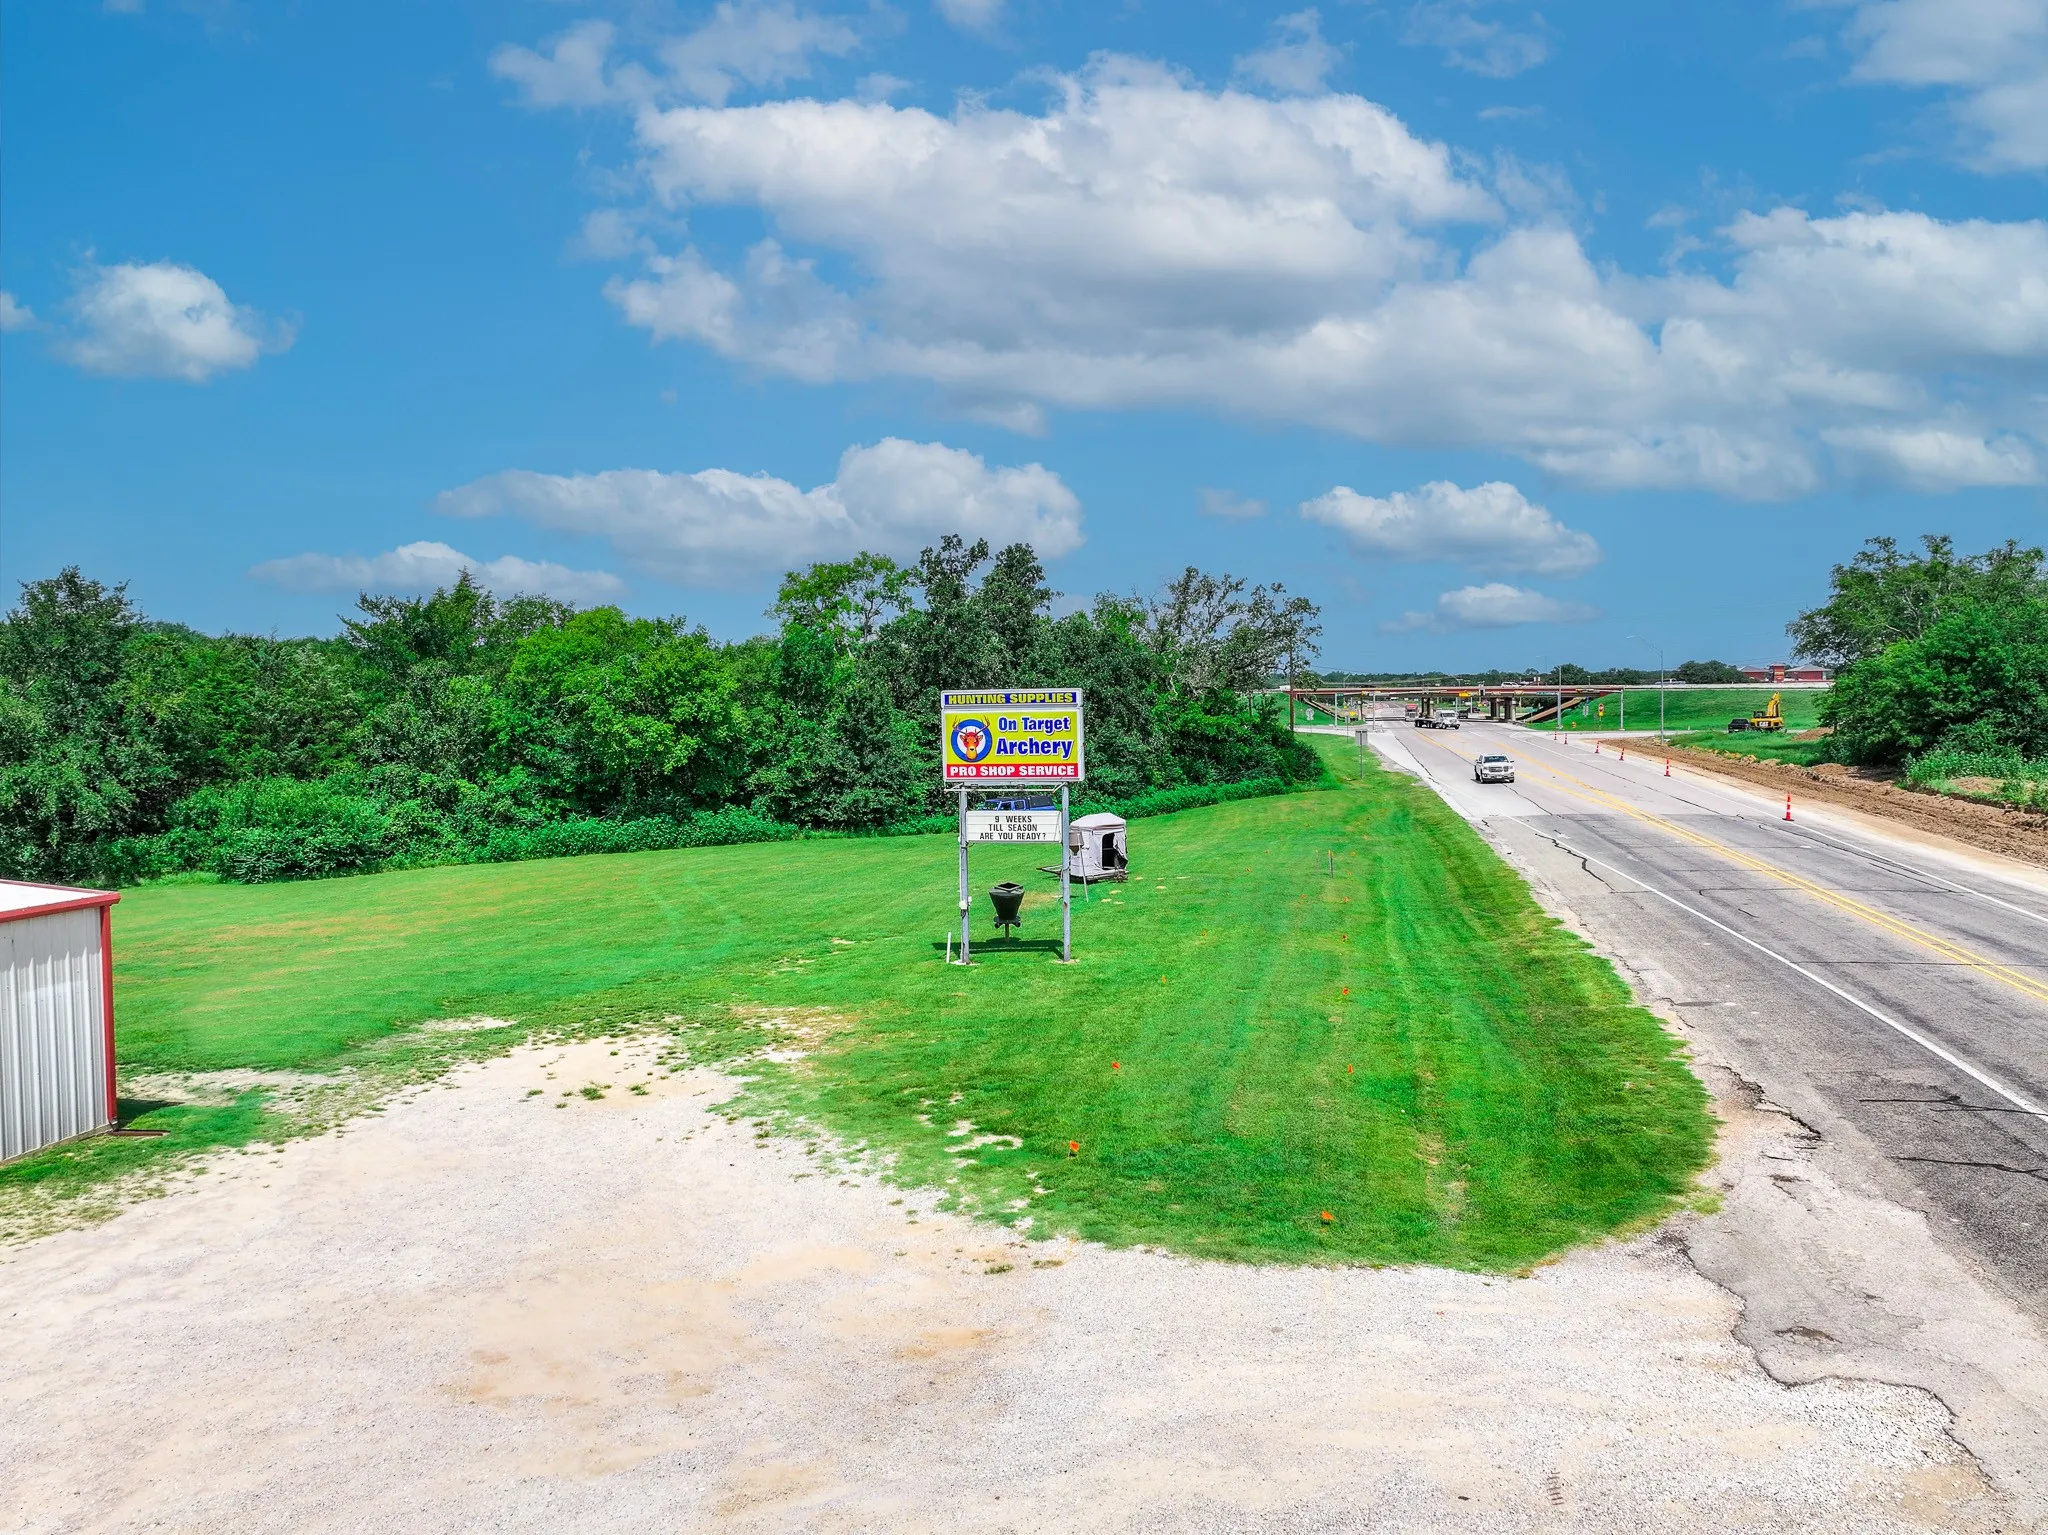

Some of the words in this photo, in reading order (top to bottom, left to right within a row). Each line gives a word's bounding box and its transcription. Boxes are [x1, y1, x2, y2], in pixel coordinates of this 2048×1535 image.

[949, 694, 1005, 705] HUNTING
[1010, 693, 1073, 704] SUPPLIES
[998, 717, 1017, 731] On
[1022, 717, 1070, 734] Target
[996, 738, 1073, 758] Archery
[950, 766, 976, 776] PRO
[980, 766, 1015, 776] SHOP
[1019, 765, 1075, 776] SERVICE
[994, 815, 1000, 823] 9
[1005, 815, 1032, 823] WEEKS
